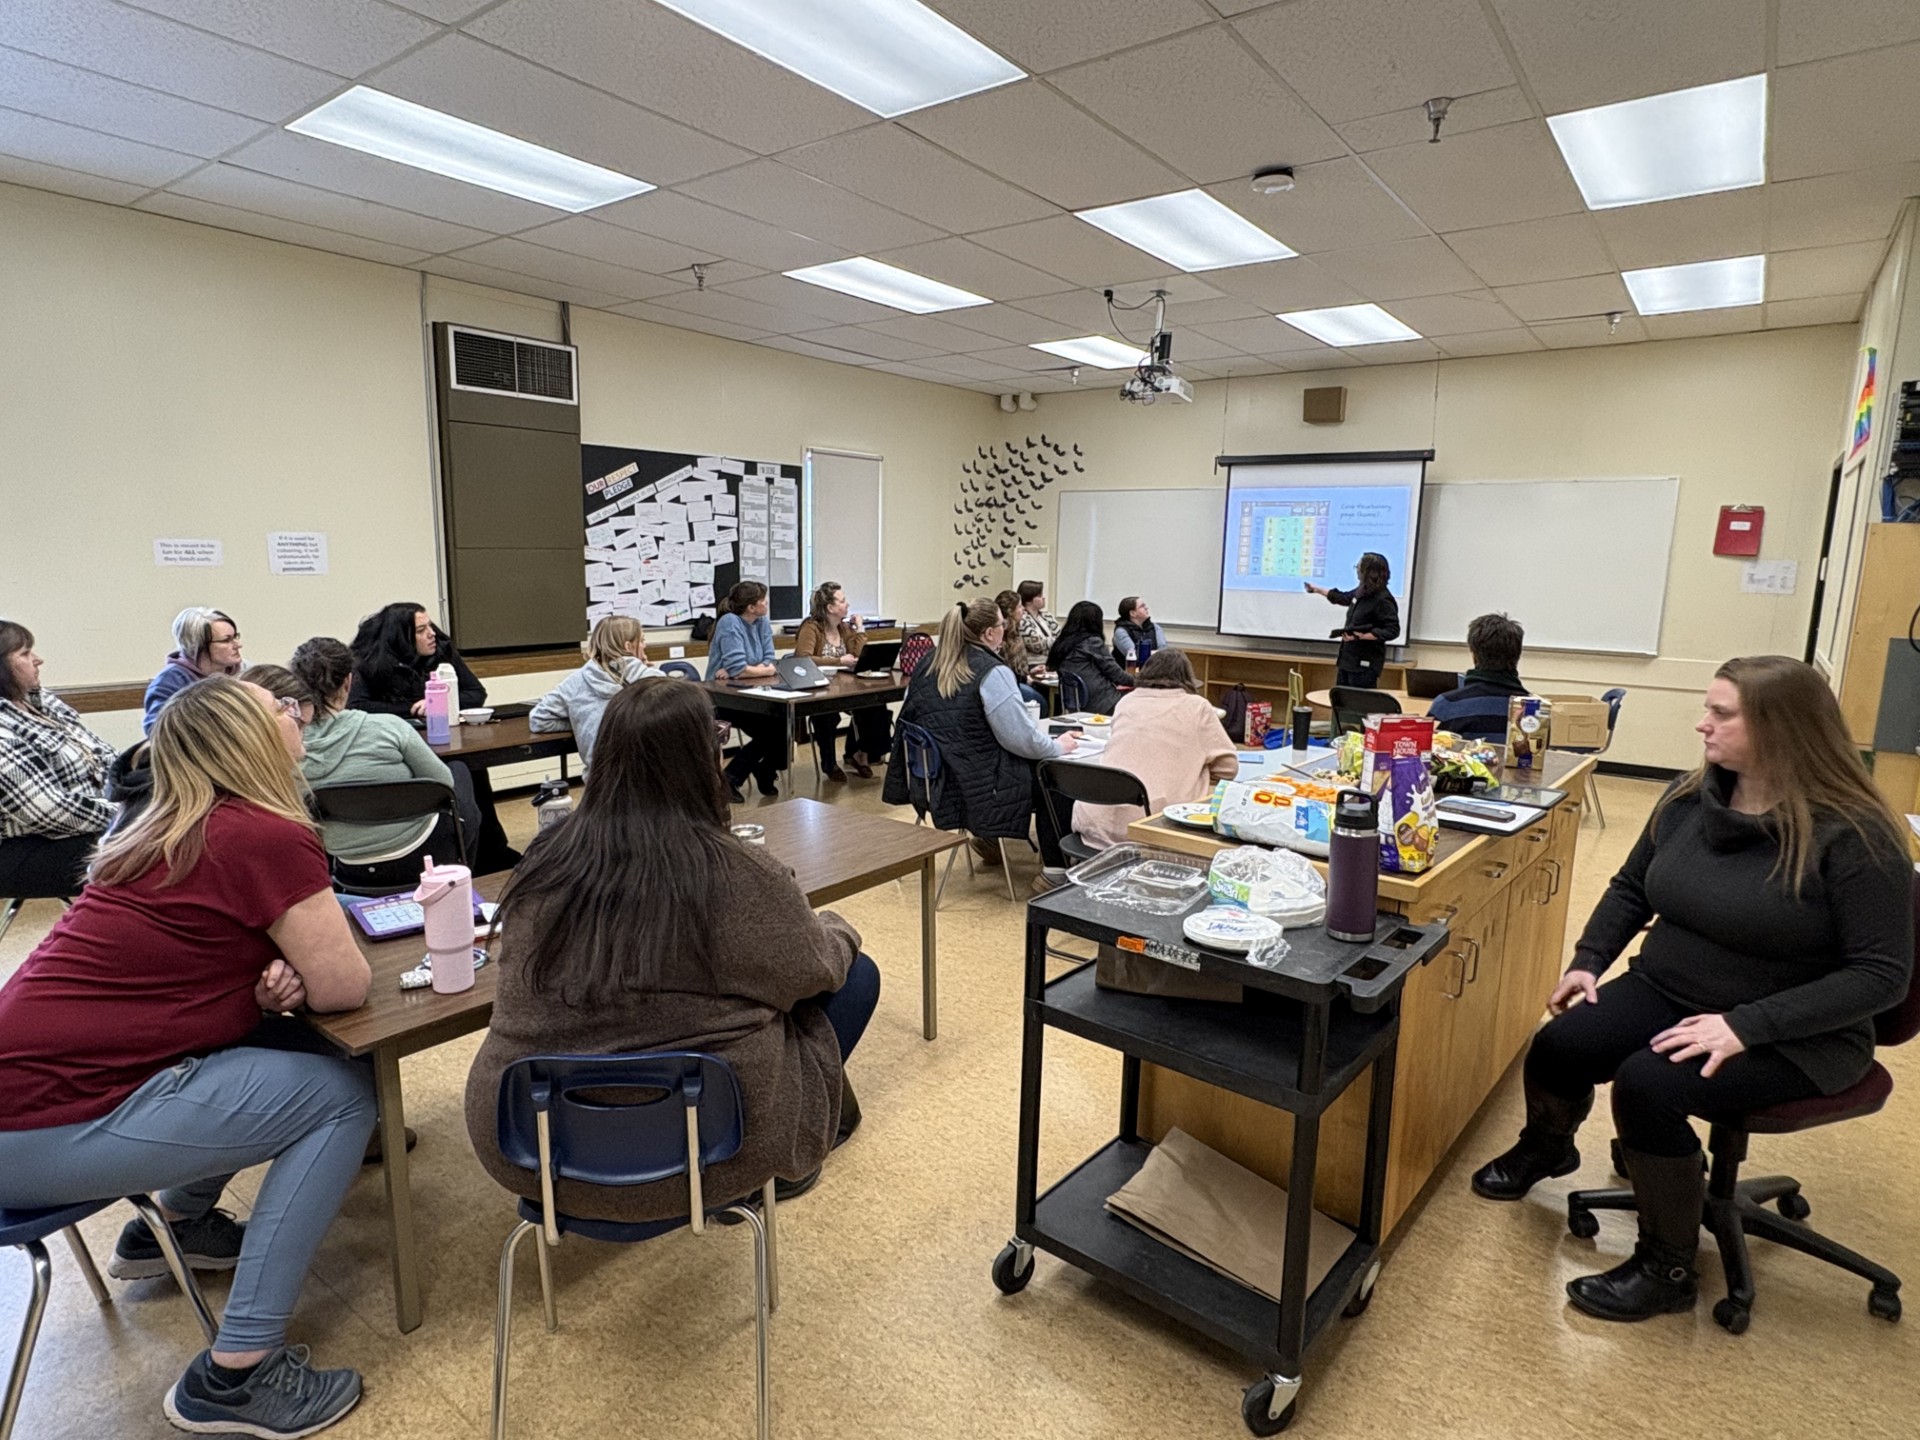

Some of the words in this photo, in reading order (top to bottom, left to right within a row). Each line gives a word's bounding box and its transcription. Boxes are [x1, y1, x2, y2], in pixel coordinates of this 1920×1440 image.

[587, 481, 604, 492] OUR
[607, 464, 637, 484] RESPECT
[604, 481, 632, 498] PLEDGE
[620, 495, 640, 508] respect
[1393, 740, 1417, 749] TOWN
[1393, 748, 1418, 756] HOUSE
